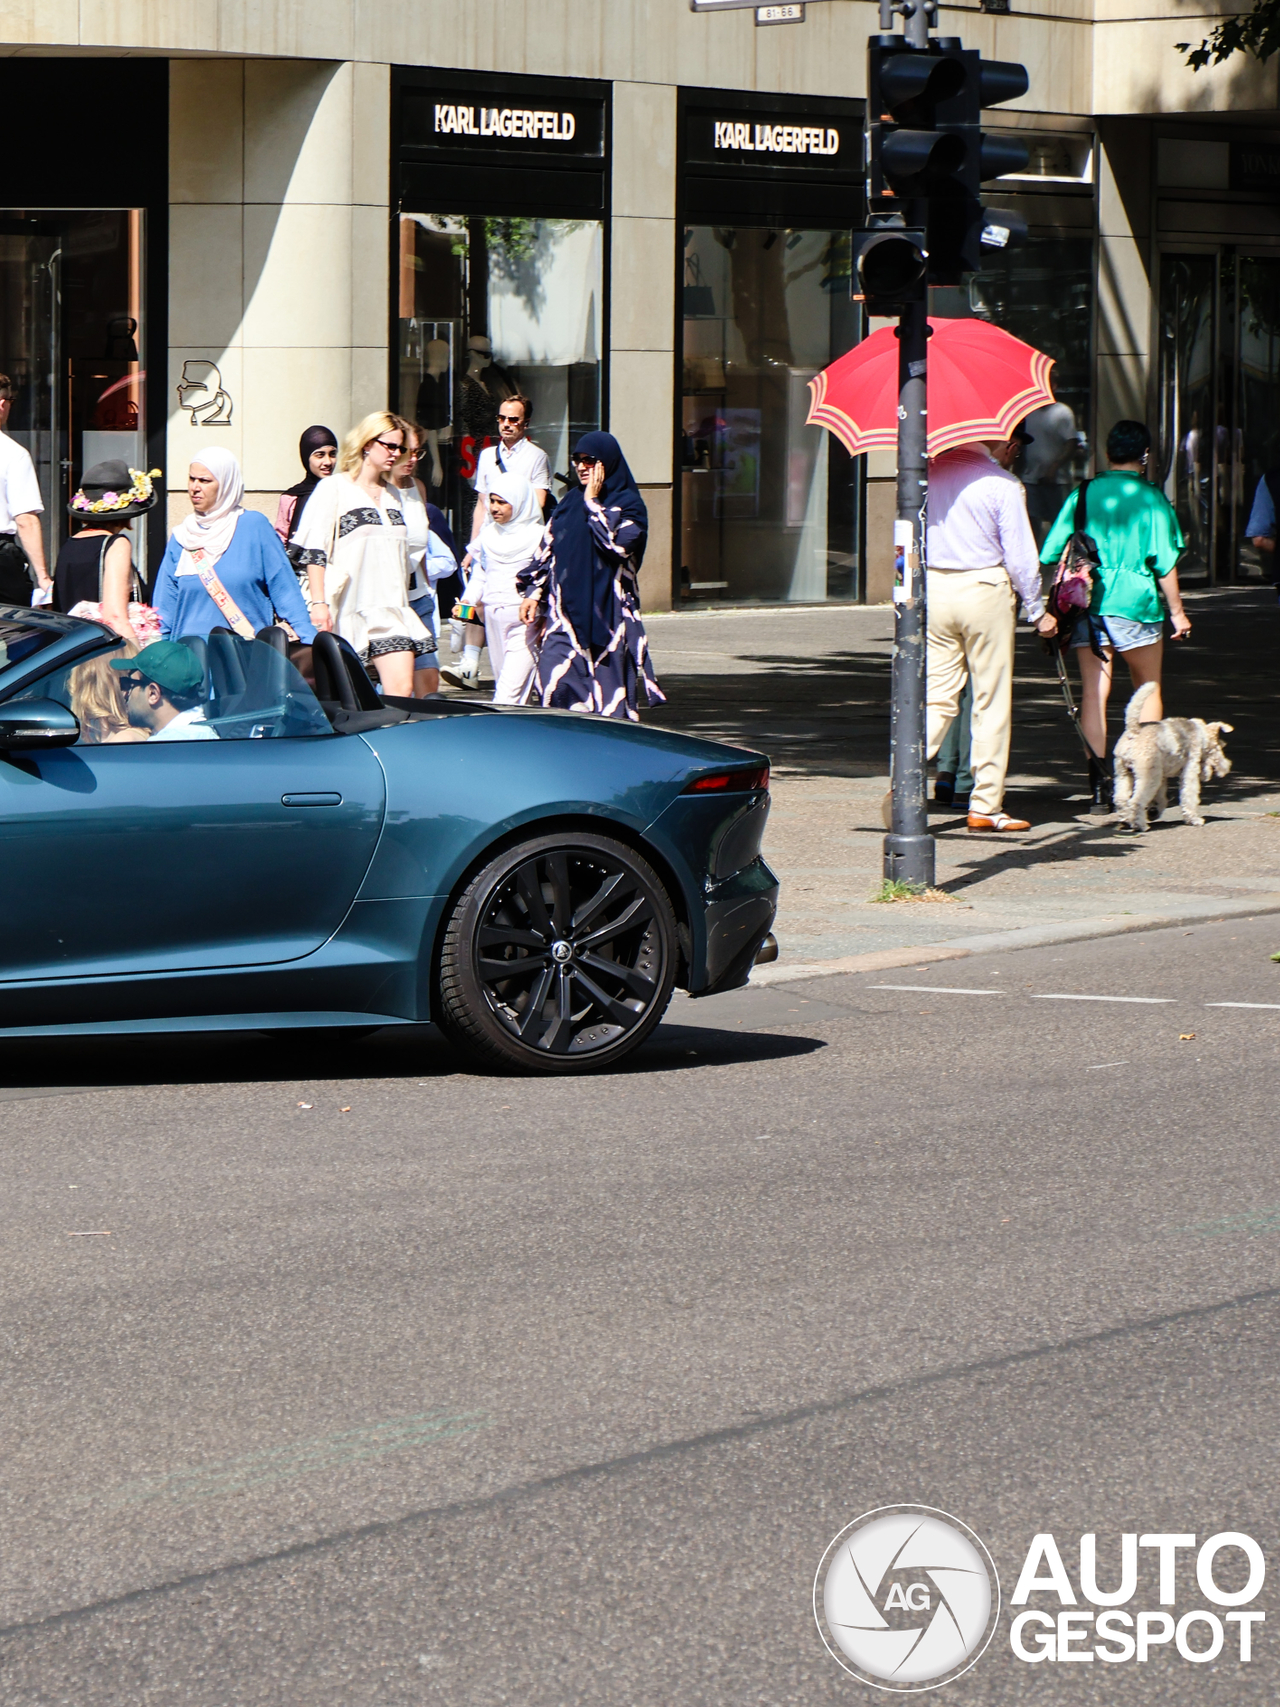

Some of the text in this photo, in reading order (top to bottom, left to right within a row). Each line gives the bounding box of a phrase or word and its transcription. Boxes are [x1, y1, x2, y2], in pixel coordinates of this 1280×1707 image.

[434, 104, 576, 141] KARL LAGERFELD
[714, 121, 840, 155] KARL LAGERFELD
